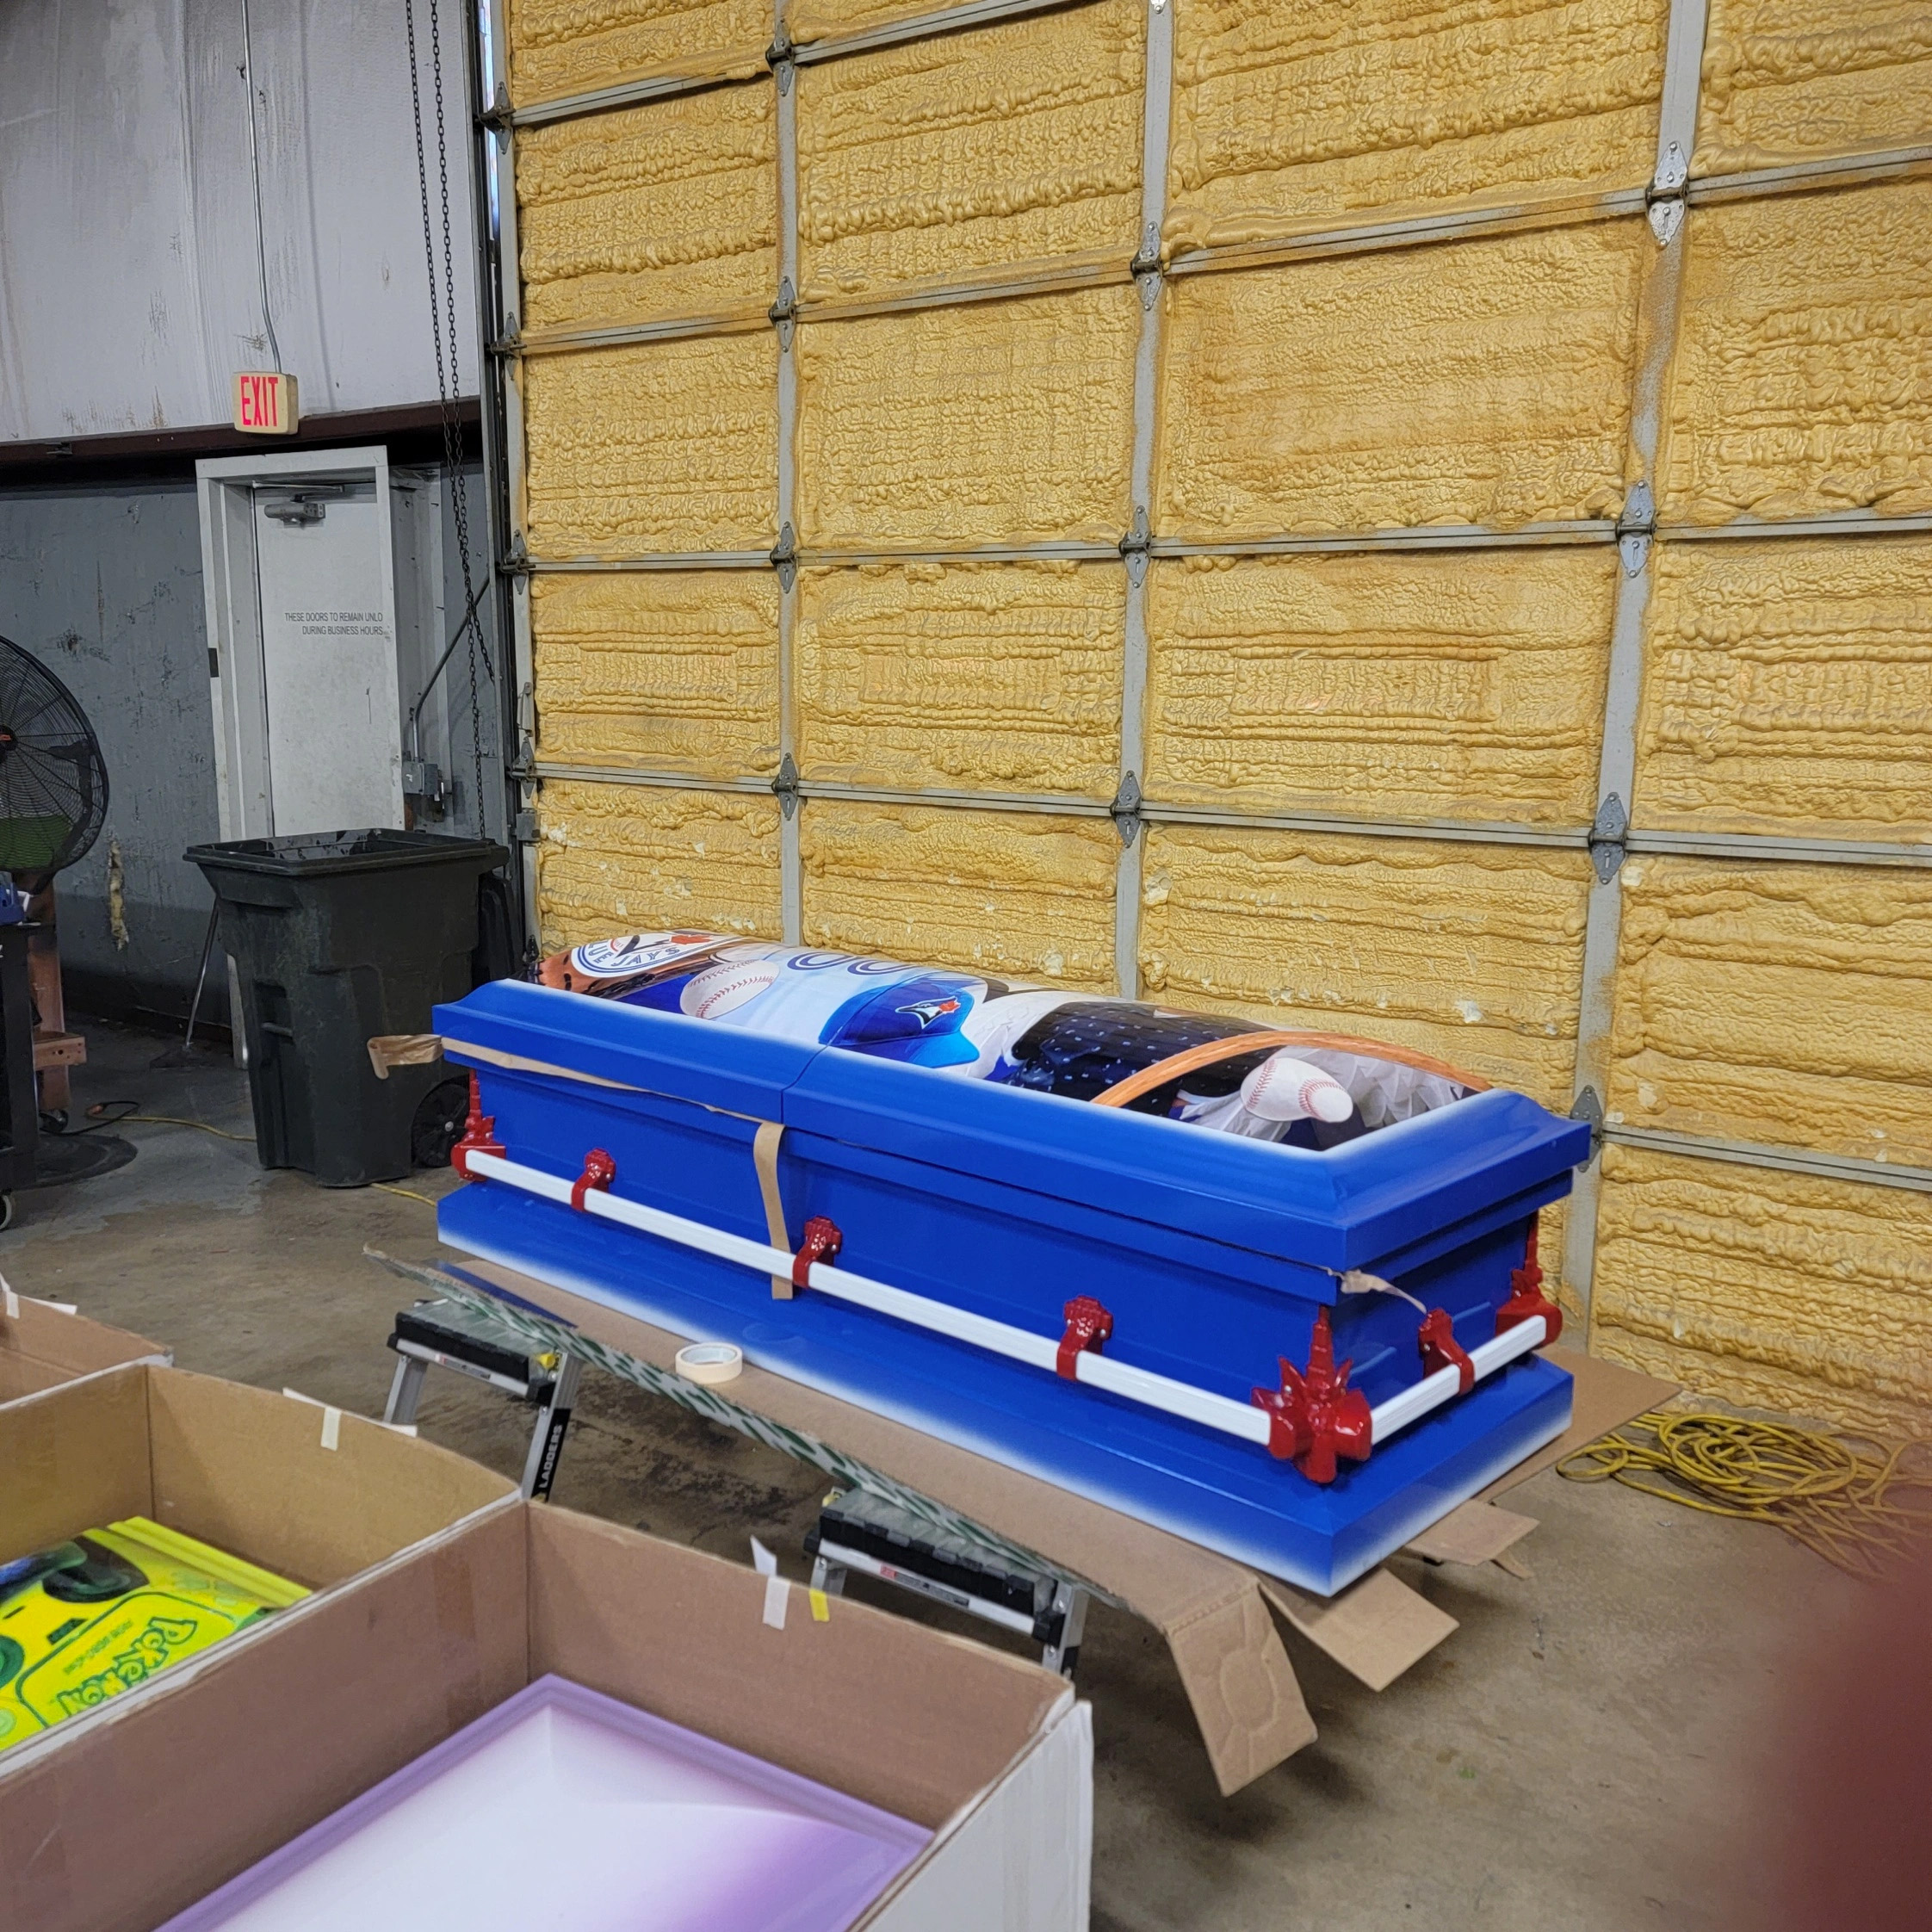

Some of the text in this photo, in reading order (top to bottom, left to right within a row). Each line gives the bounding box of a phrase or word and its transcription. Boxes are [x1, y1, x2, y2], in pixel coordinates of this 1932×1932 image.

[240, 375, 278, 426] EXIT
[284, 612, 305, 622] THESE
[306, 612, 328, 622] DOORS
[329, 612, 338, 622] TO
[339, 612, 363, 622] REMAIN
[302, 626, 383, 635] DURING BUSINESS HOURS
[610, 947, 681, 967] JAYS
[538, 1424, 563, 1489] LADDERS
